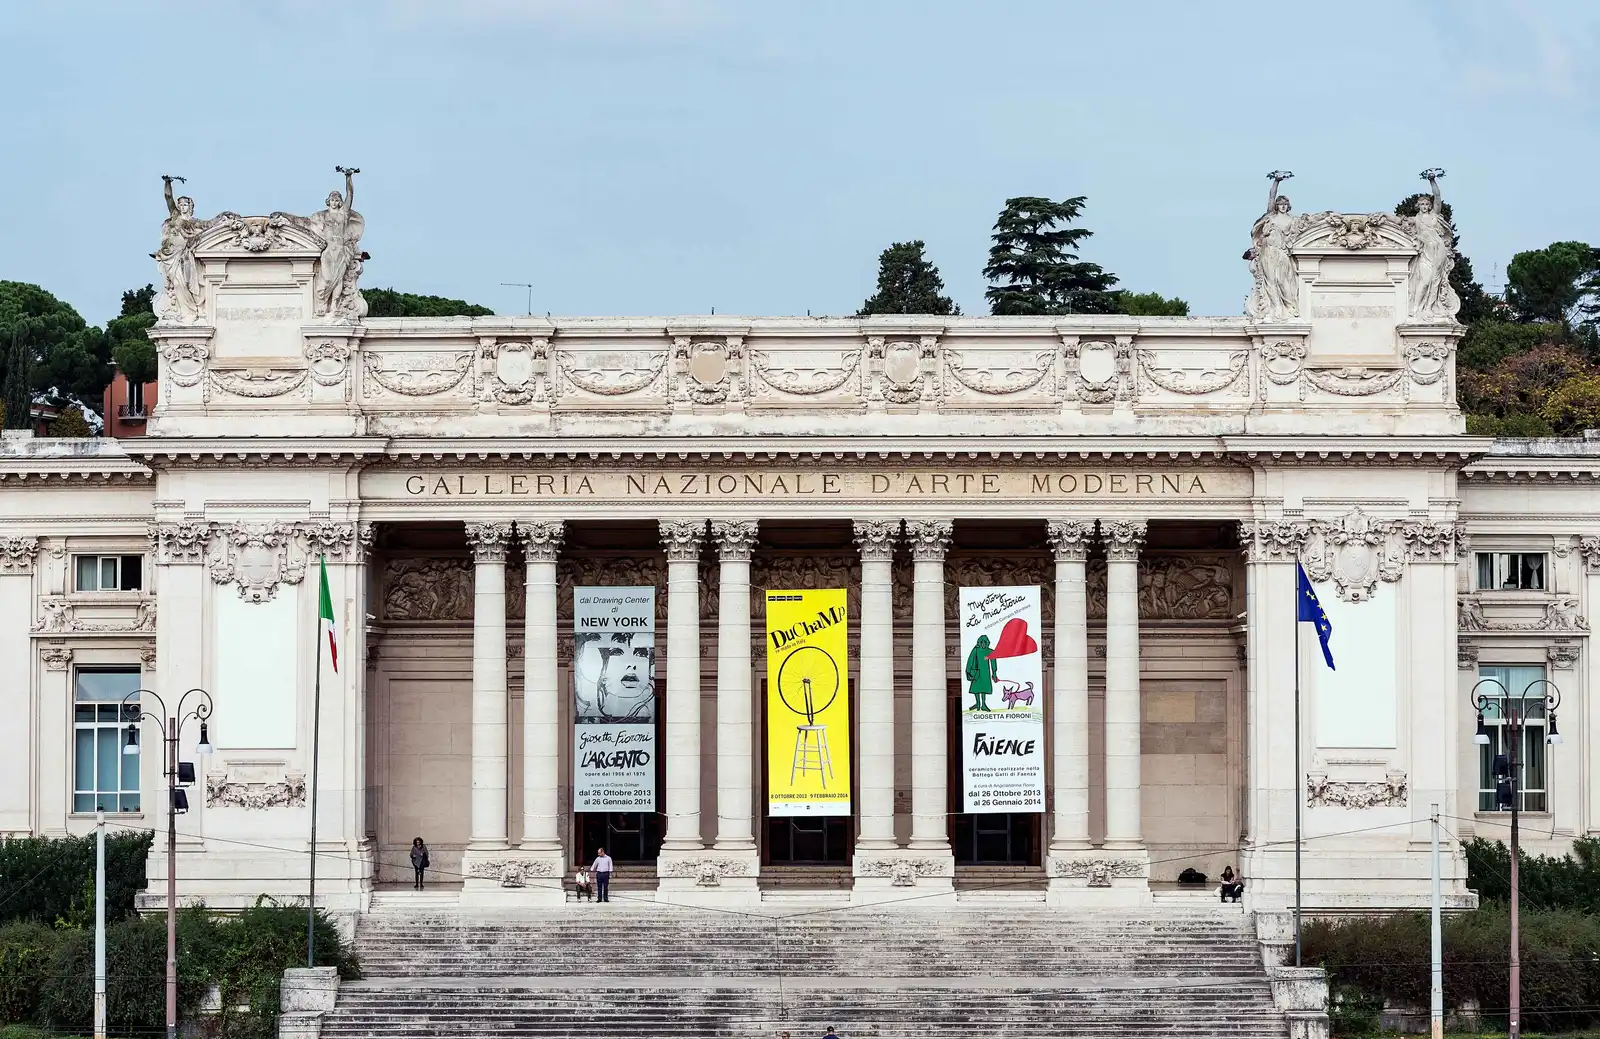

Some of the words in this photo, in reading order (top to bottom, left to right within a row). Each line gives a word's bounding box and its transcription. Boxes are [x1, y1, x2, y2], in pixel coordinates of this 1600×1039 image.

[406, 474, 596, 495] GALLERIA
[626, 473, 842, 494] NAZIONALE
[871, 472, 1001, 494] D'ARTE
[1030, 473, 1208, 494] MODERNA
[593, 597, 623, 605] Drawing
[581, 617, 610, 627] NEW
[613, 617, 648, 627] YORK
[614, 730, 653, 747] Fioroni
[580, 749, 651, 770] L'ARGENTO
[578, 789, 591, 797] dal
[592, 789, 602, 797] 26
[603, 789, 632, 797] Ottobre
[633, 789, 652, 797] 2013
[968, 790, 980, 798] dal
[992, 789, 1022, 797] Ottobre
[1023, 789, 1041, 797] 2013
[992, 798, 1023, 806] Gennaio
[1024, 798, 1041, 806] 2014
